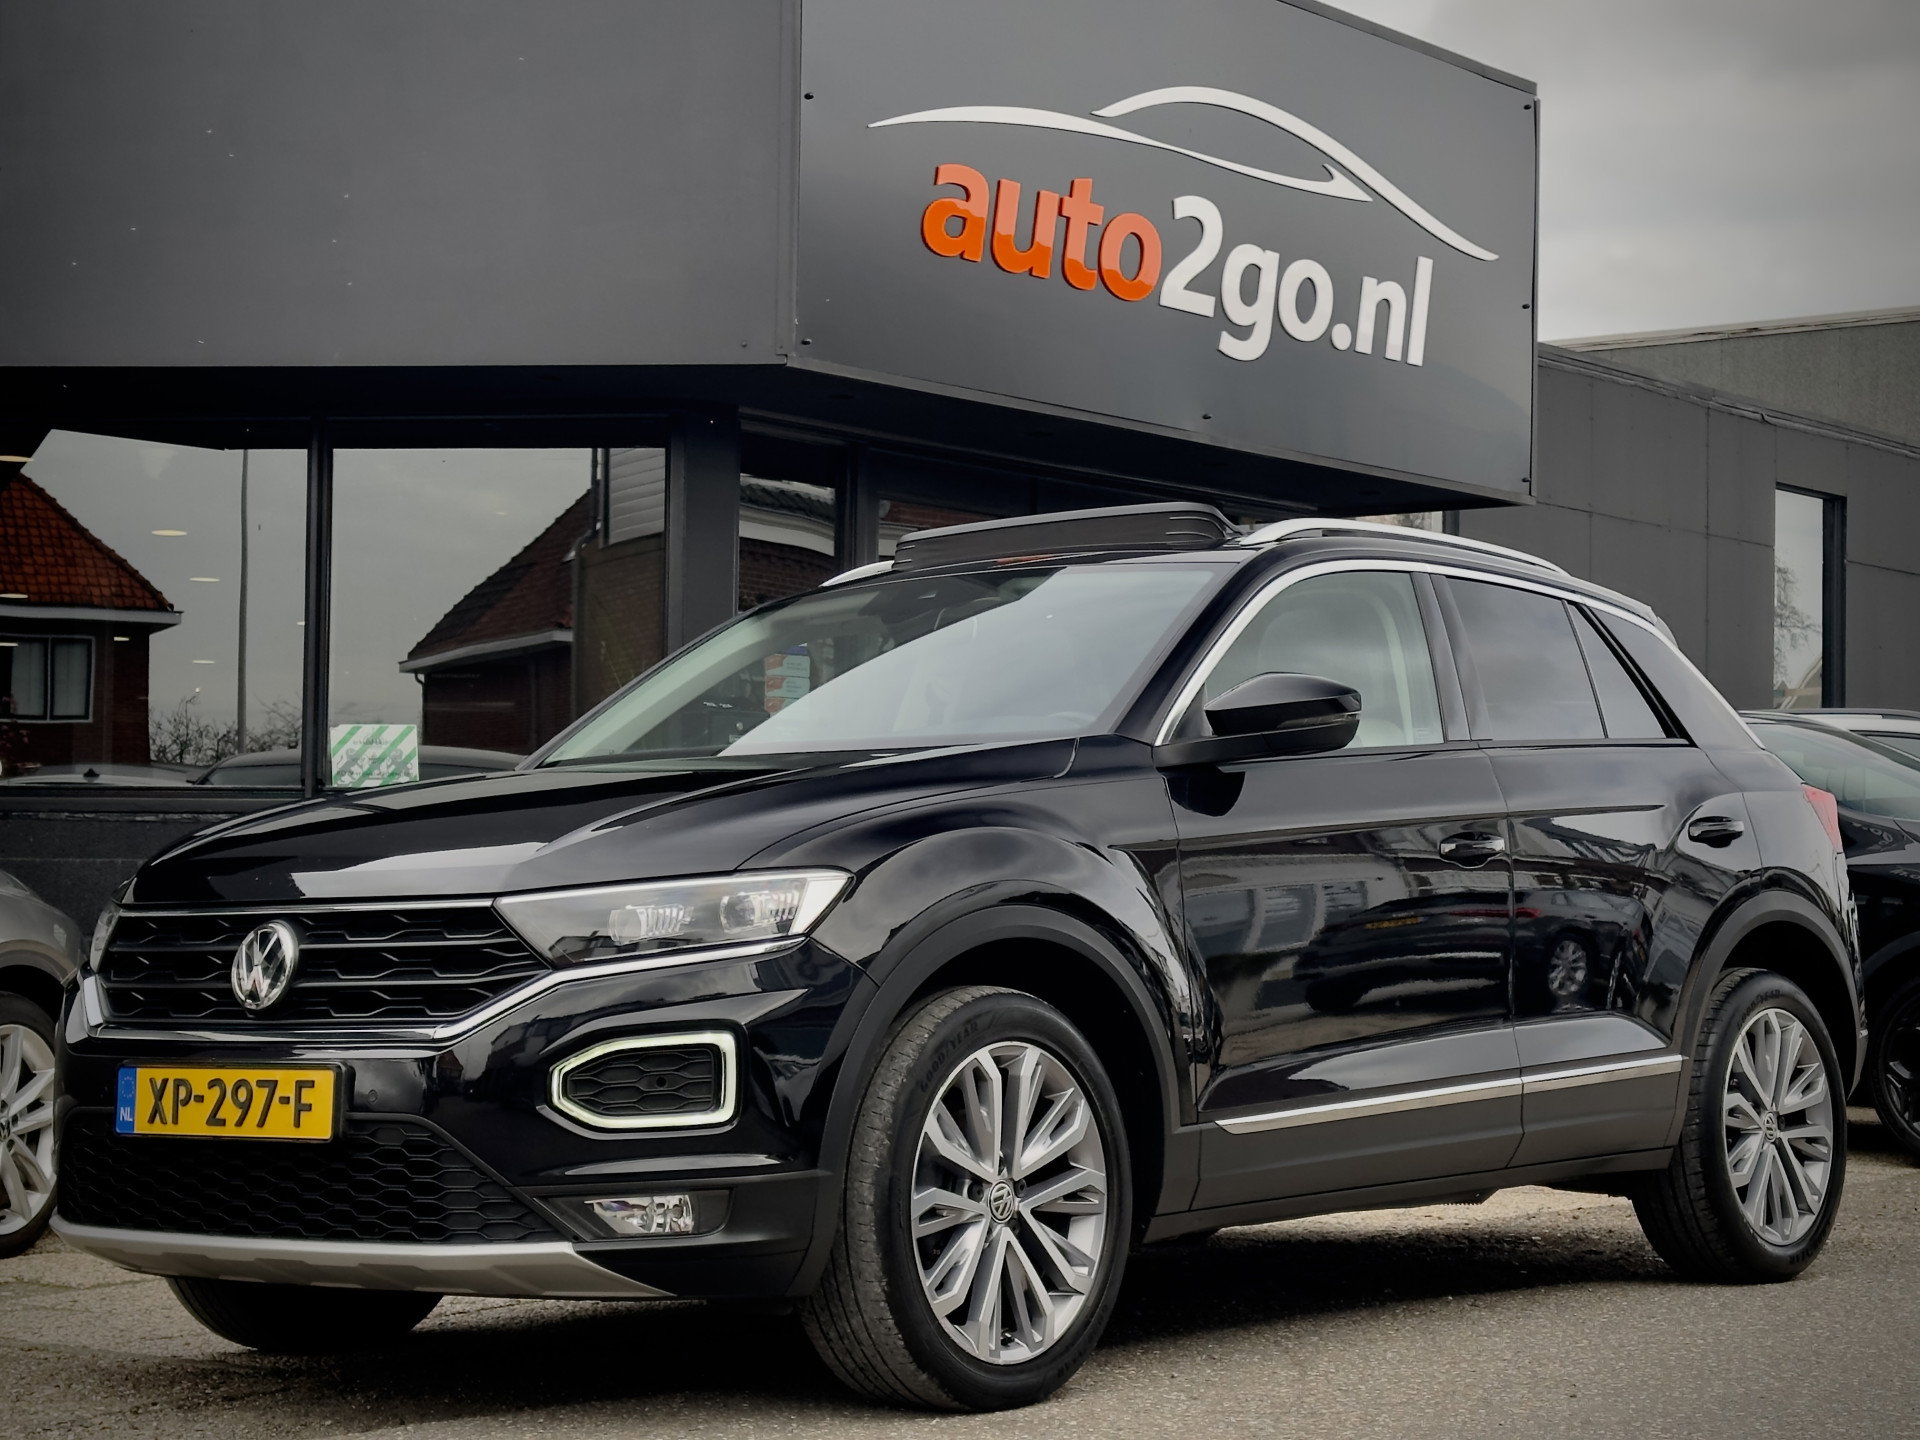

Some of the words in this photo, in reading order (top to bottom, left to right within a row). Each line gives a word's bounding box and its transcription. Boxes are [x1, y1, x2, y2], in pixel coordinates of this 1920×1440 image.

[921, 163, 1433, 366] auto2go.nl
[120, 1106, 133, 1121] NL
[147, 1077, 315, 1128] XP-297-F
